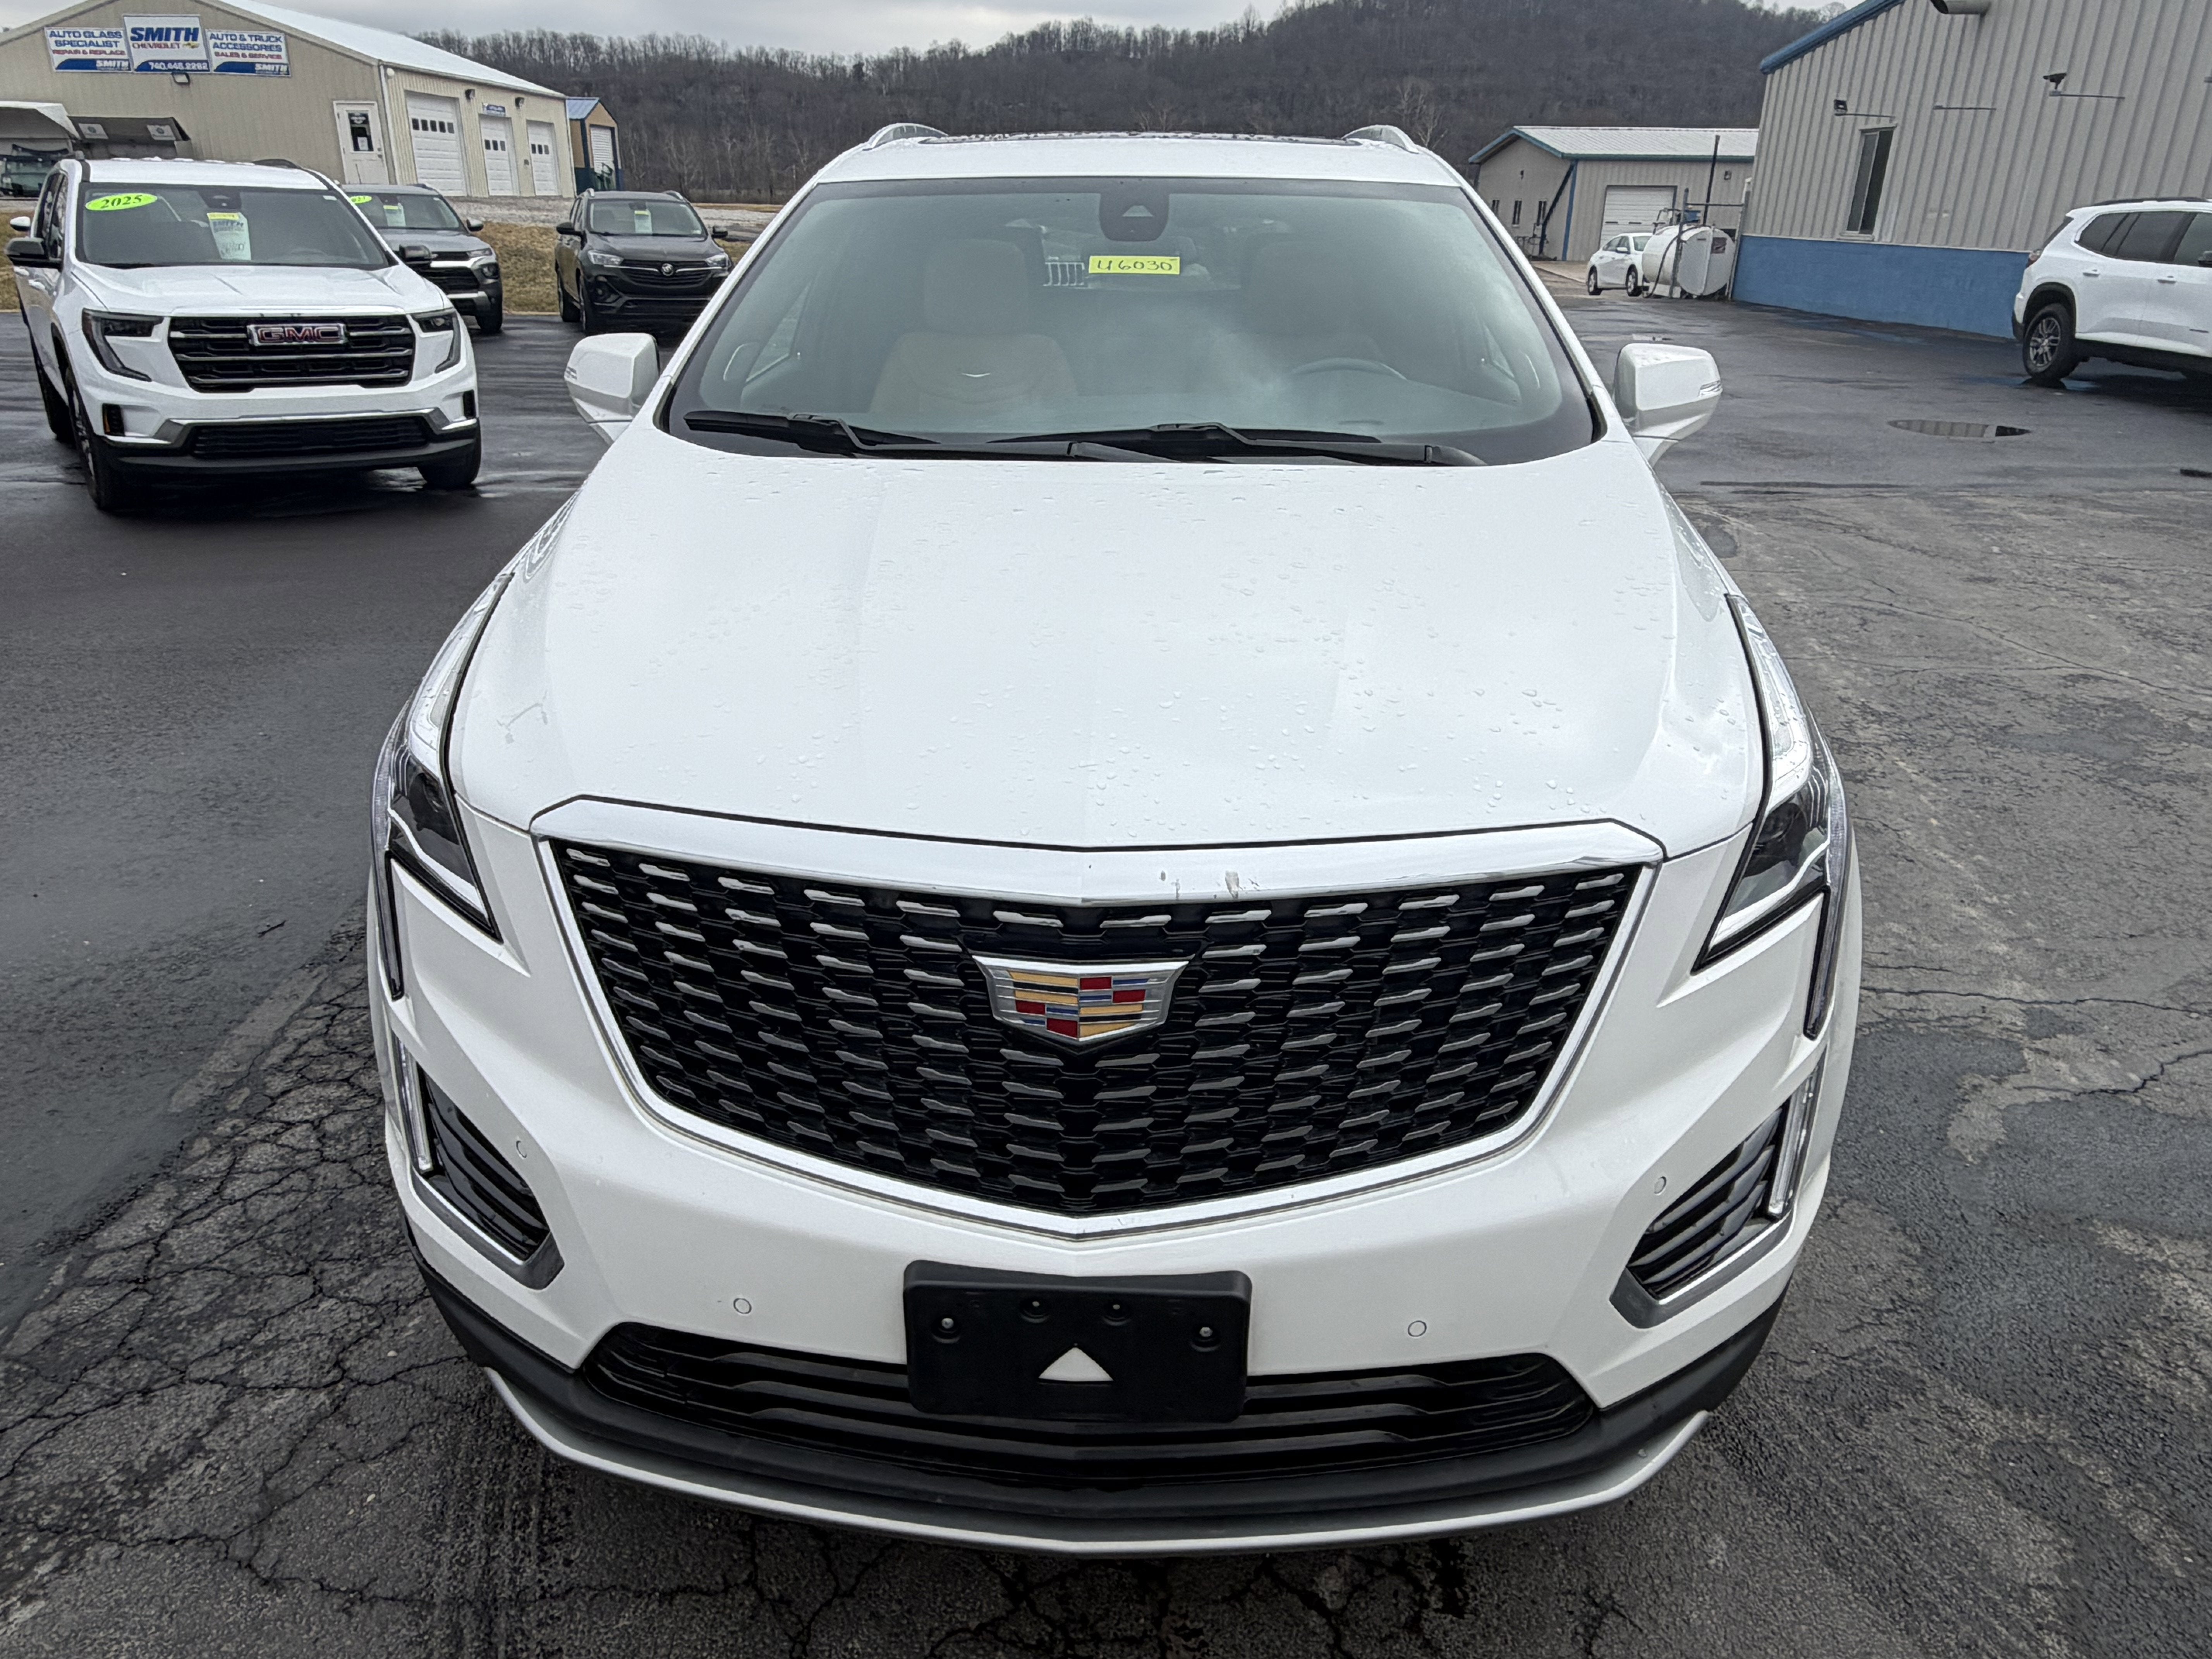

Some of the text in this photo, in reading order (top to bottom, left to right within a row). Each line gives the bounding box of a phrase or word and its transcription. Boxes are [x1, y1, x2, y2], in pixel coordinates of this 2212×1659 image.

[130, 27, 199, 41] SMITH
[210, 33, 237, 41] AUTO
[248, 34, 282, 43] TRUCK
[213, 42, 282, 52] ACCESSORIES
[100, 195, 143, 209] 2025
[258, 327, 339, 342] GMC
